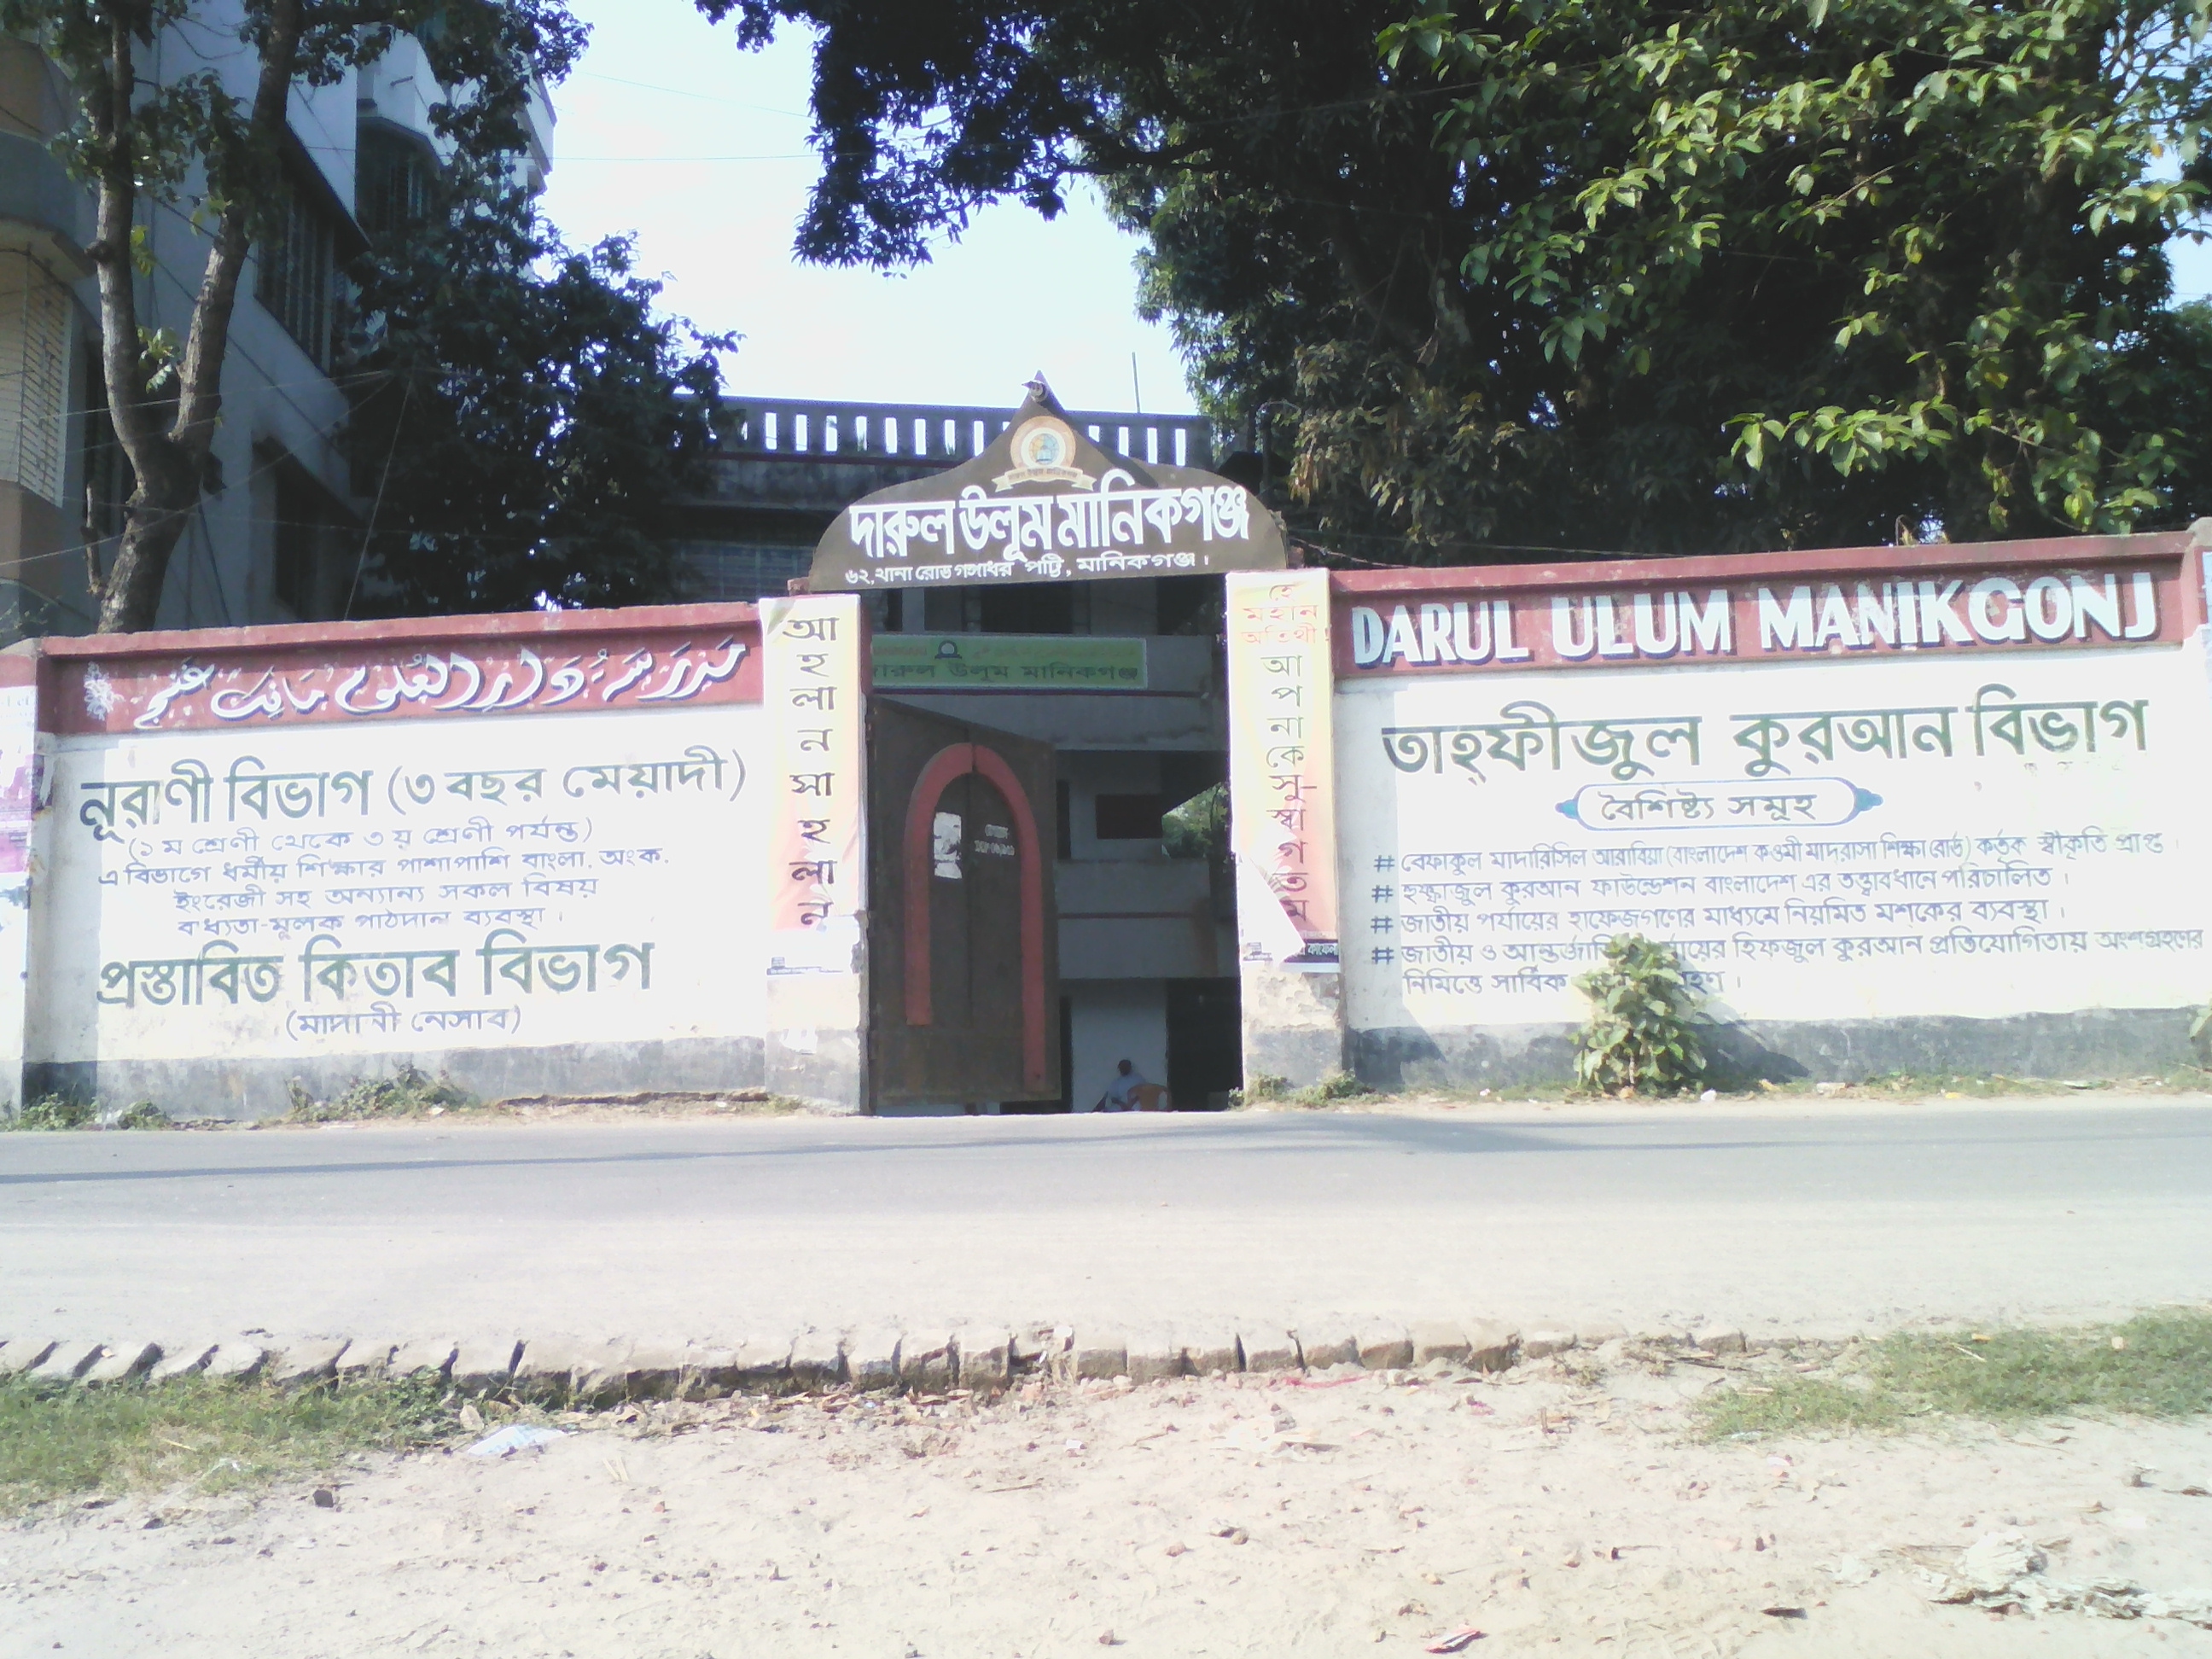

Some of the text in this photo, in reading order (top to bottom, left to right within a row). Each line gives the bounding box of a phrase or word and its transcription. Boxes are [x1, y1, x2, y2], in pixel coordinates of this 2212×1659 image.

[849, 469, 1250, 562] দারুল উলূম মানিকগঞ্জ
[916, 564, 952, 581] রোড
[1352, 571, 2161, 666] DARUL ULUM MANIKGONJ
[1729, 707, 1958, 777] কুরআন
[1965, 683, 2149, 757] বিভাগ
[80, 758, 214, 844] নূরাণী
[223, 755, 374, 822] বিভাগ
[444, 768, 548, 806] বছর
[562, 745, 747, 802] মেয়াদী)
[1598, 789, 1818, 822] বৈশিষ্ট্য সমূহ
[192, 827, 259, 854] শ্রেণী
[271, 831, 354, 852] থেকে
[423, 816, 495, 845] শ্রেণী
[1401, 852, 1483, 876] বেফাকুল
[1490, 841, 1587, 870] মাদারিসিল
[1592, 840, 1664, 867] আরাবিয়া
[1752, 835, 1803, 862] কওমী
[1880, 831, 1927, 859] শিক্ষা
[98, 869, 119, 886] এ
[124, 862, 212, 885] বিভাগে
[223, 856, 288, 882] ধর্মীয়
[398, 846, 511, 873] পাশাপাশি
[1500, 880, 1581, 905] কুরআন
[1591, 872, 1697, 897] ফাউন্ডেশন
[1704, 875, 1797, 895] বাংলাদেশ
[1802, 873, 1832, 893] এর
[1941, 859, 2054, 890] পরিচালিত
[173, 871, 598, 912] ইংরেজী সহ অন্যান্য সকল বিষয়
[463, 907, 546, 929] ব্যবস্থা
[1401, 905, 1470, 934] জাতীয়
[1477, 906, 1559, 932] পর্যায়ের
[1703, 905, 1779, 927] মাধ্যমে
[1784, 896, 1867, 926] নিয়মিত
[1969, 899, 2049, 924] ব্যবস্থা
[1401, 935, 1474, 965] জাতীয়
[1479, 943, 1497, 961] ও
[1732, 931, 1826, 963] হিফজুল
[1831, 935, 1924, 962] কুরআন
[1930, 925, 2088, 954] প্রতিযোগিতায়
[96, 928, 655, 1009] প্রস্তাবিত কিতাব বিভাগ
[1403, 968, 1483, 995] নিমিত্তে
[1491, 966, 1569, 994] সার্বিক
